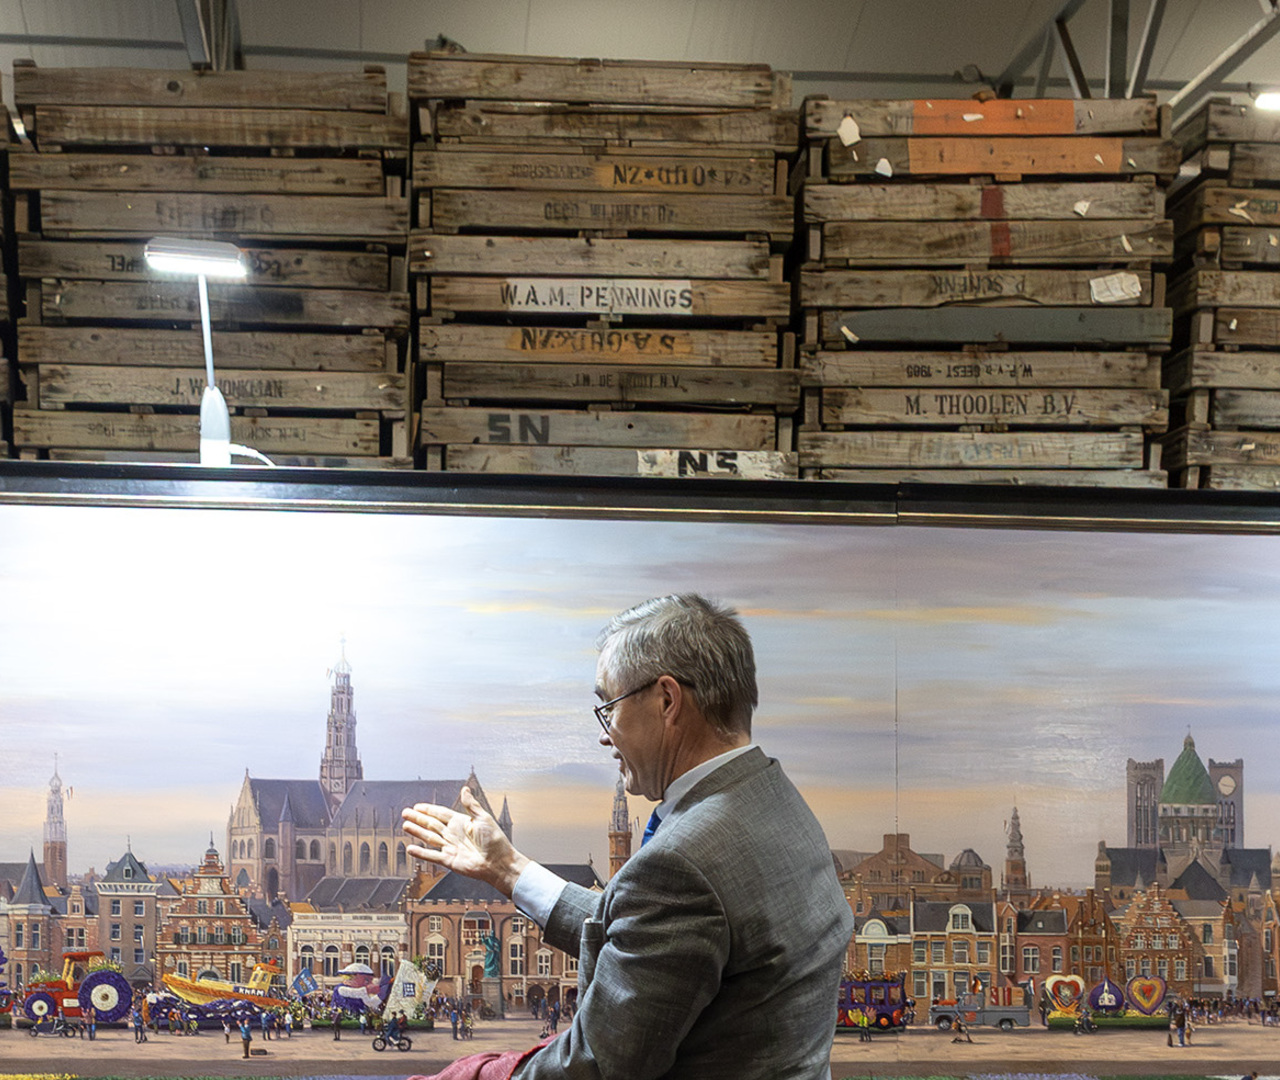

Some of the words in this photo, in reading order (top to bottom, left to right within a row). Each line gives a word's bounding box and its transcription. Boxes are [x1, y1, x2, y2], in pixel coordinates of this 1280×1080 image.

[580, 284, 693, 309] PENNINGS
[905, 364, 932, 378] 1985
[904, 394, 928, 416] M.
[934, 394, 1029, 416] THOOLEN
[1041, 394, 1083, 416] B.V.
